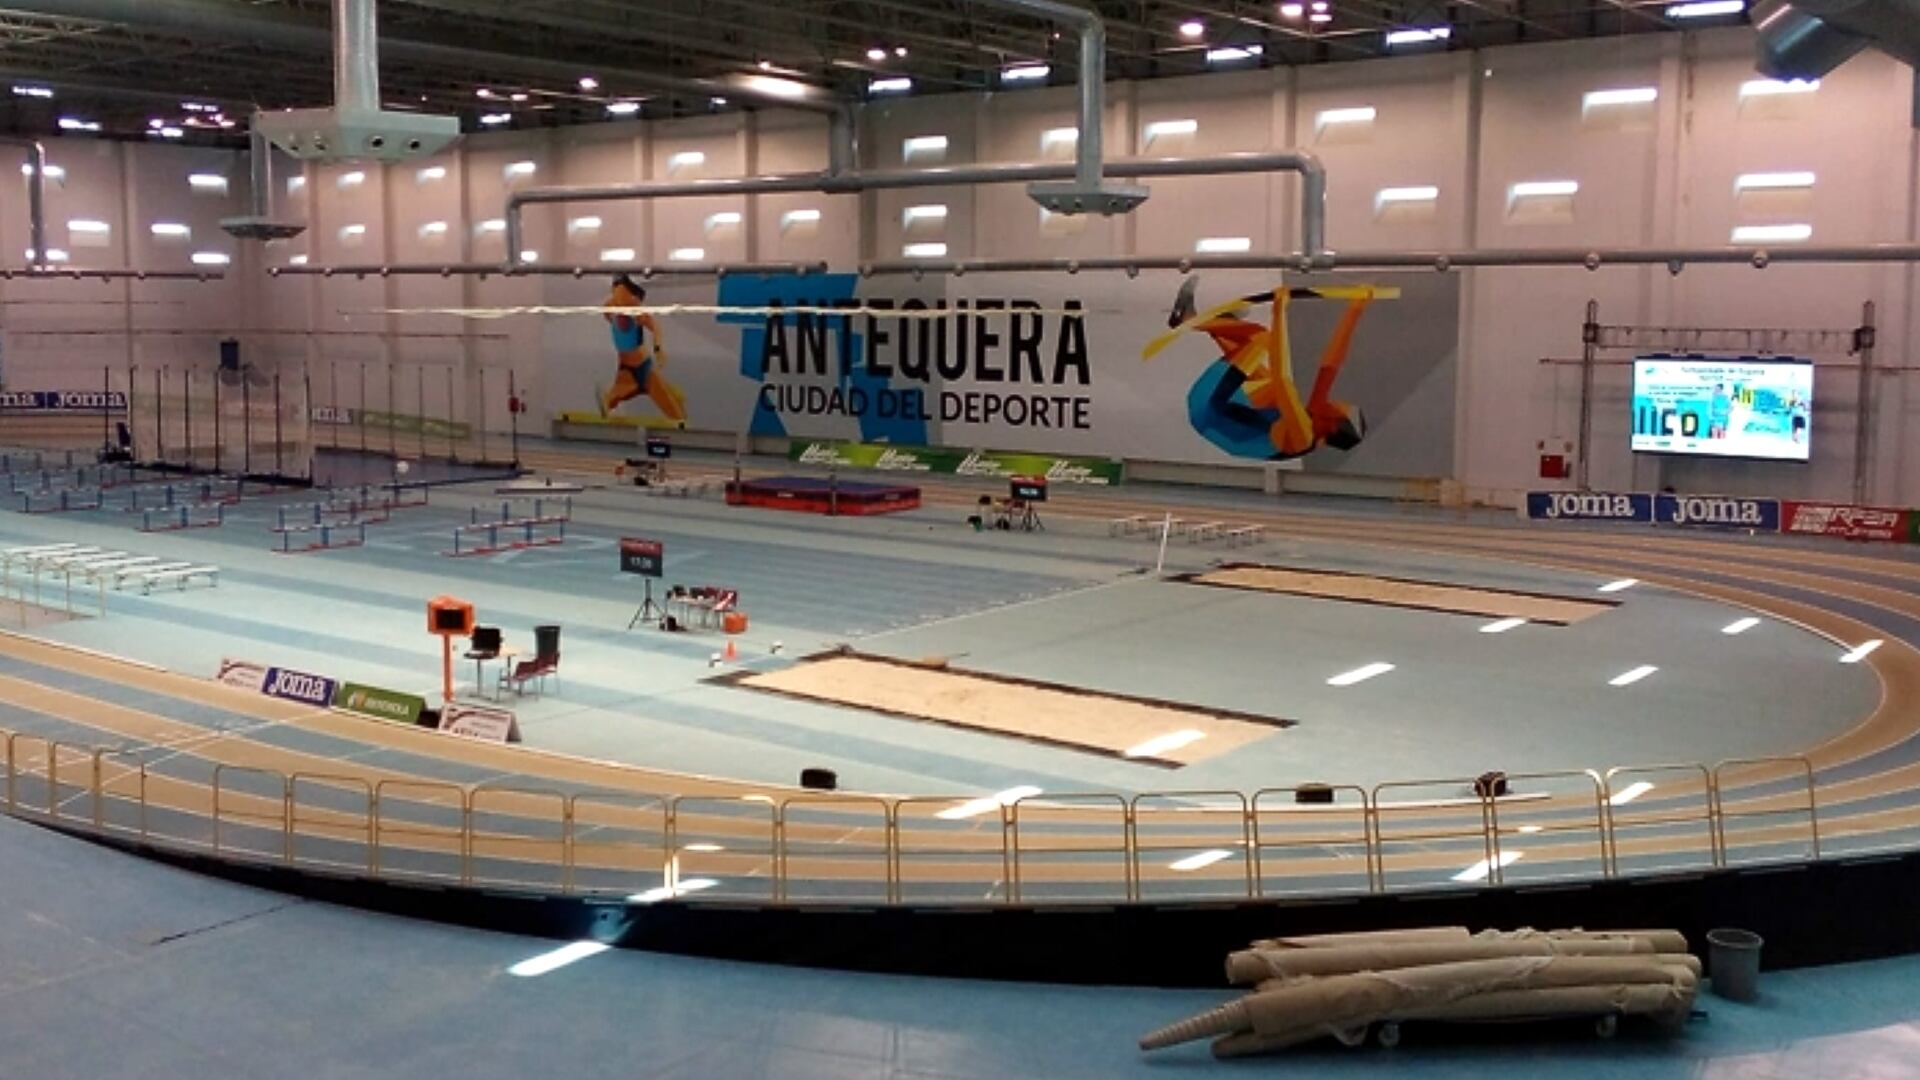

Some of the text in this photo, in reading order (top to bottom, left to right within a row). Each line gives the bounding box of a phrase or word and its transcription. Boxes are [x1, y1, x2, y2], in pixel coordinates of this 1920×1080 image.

[761, 298, 1091, 385] ANTEQUERA
[759, 383, 1091, 429] CIUDAD DEL DEPORTE
